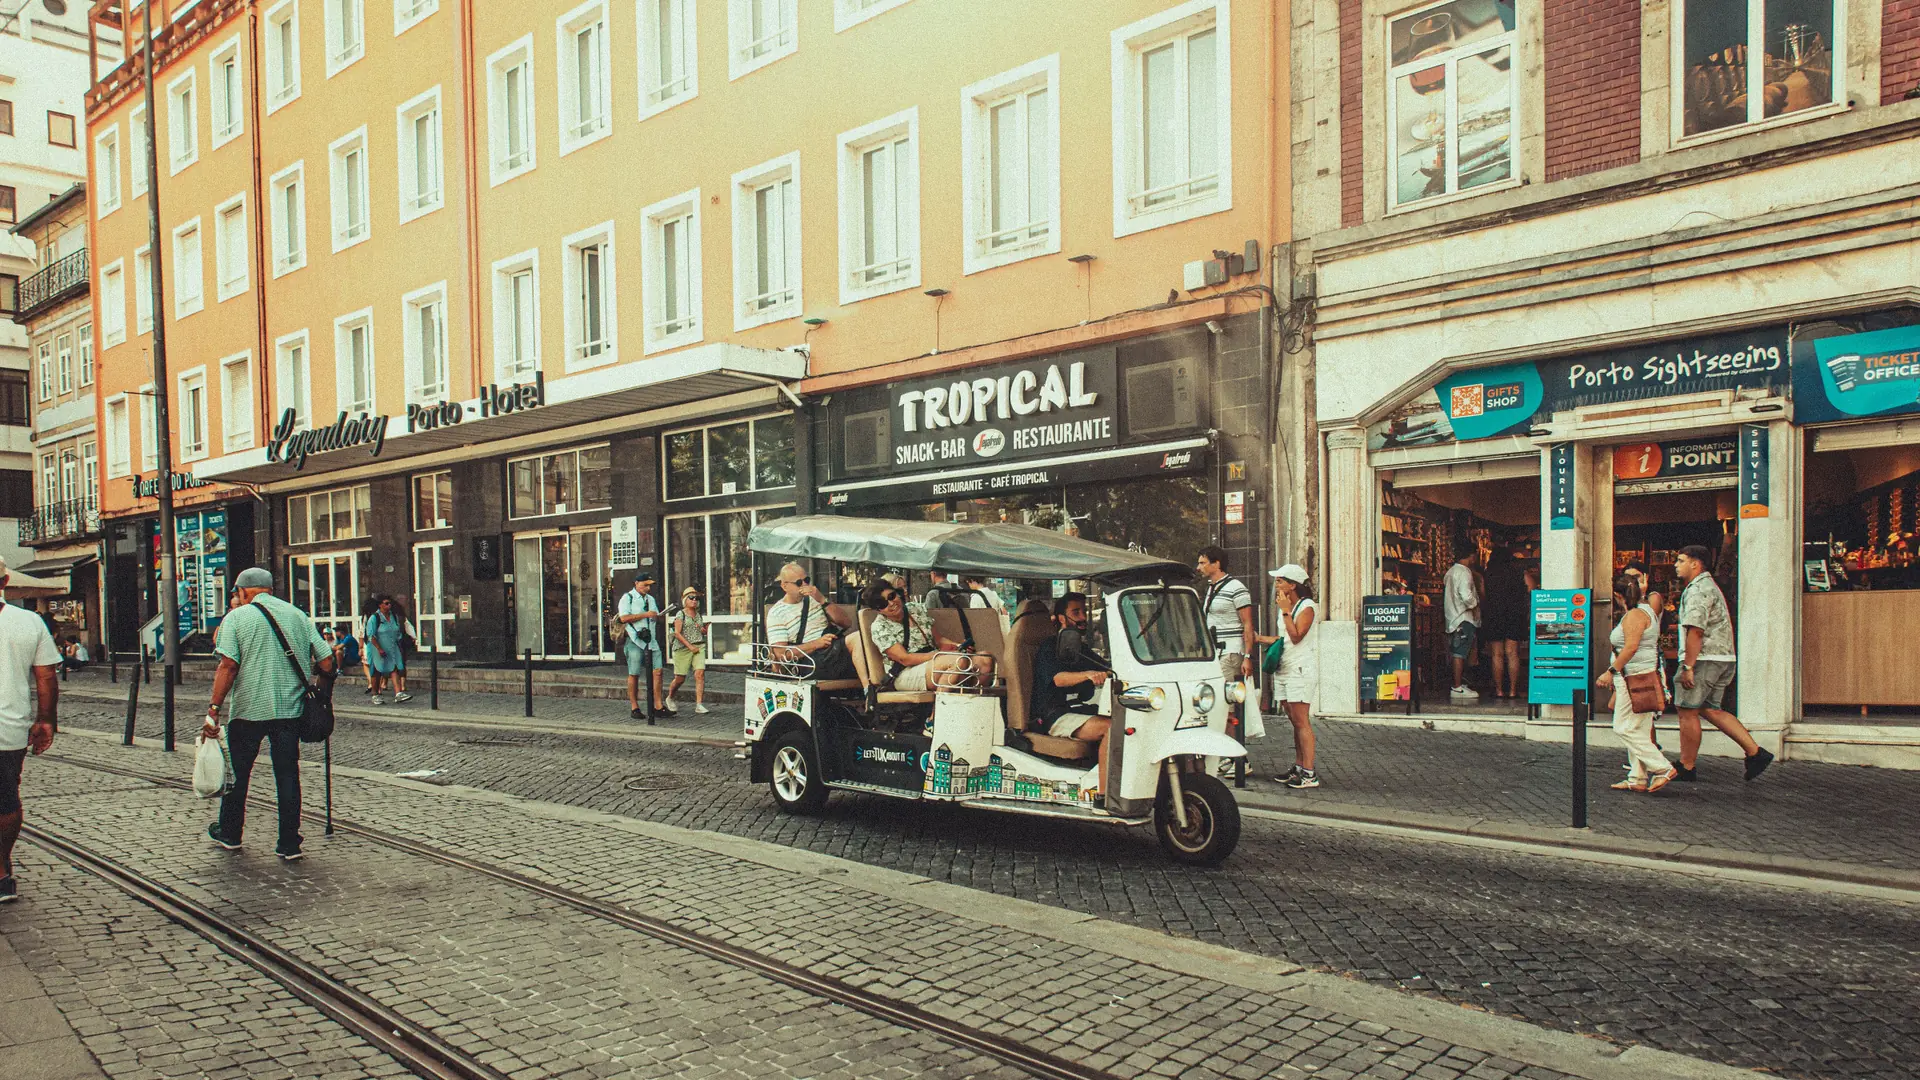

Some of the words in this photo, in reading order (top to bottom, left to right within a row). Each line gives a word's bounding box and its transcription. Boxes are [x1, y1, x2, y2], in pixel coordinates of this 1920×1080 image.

[1568, 361, 1635, 389] Porto
[1642, 345, 1782, 385] Sightseeing
[1863, 352, 1920, 368] TICKET
[1863, 364, 1920, 380] OFFICE
[898, 361, 1098, 432] TROPICAL
[1487, 385, 1520, 398] GIFTS
[1487, 396, 1517, 408] SHOP
[267, 407, 389, 471] Legendary
[407, 400, 463, 433] Porto
[480, 370, 544, 418] Hotel
[896, 437, 966, 465] SNACK-BAR
[1013, 416, 1111, 450] RESTAURANTE
[1670, 441, 1736, 453] INFORMATION
[1670, 449, 1735, 468] POINT
[1751, 429, 1759, 501] SERVICE
[933, 478, 982, 495] RESTAURANTE
[990, 474, 1010, 489] CAFÉ
[1011, 471, 1049, 486] TROPICAL
[1558, 448, 1566, 514] TOURISM
[1367, 607, 1405, 615] LUGGAGE
[1374, 615, 1399, 623] ROOM
[873, 747, 887, 762] TUK
